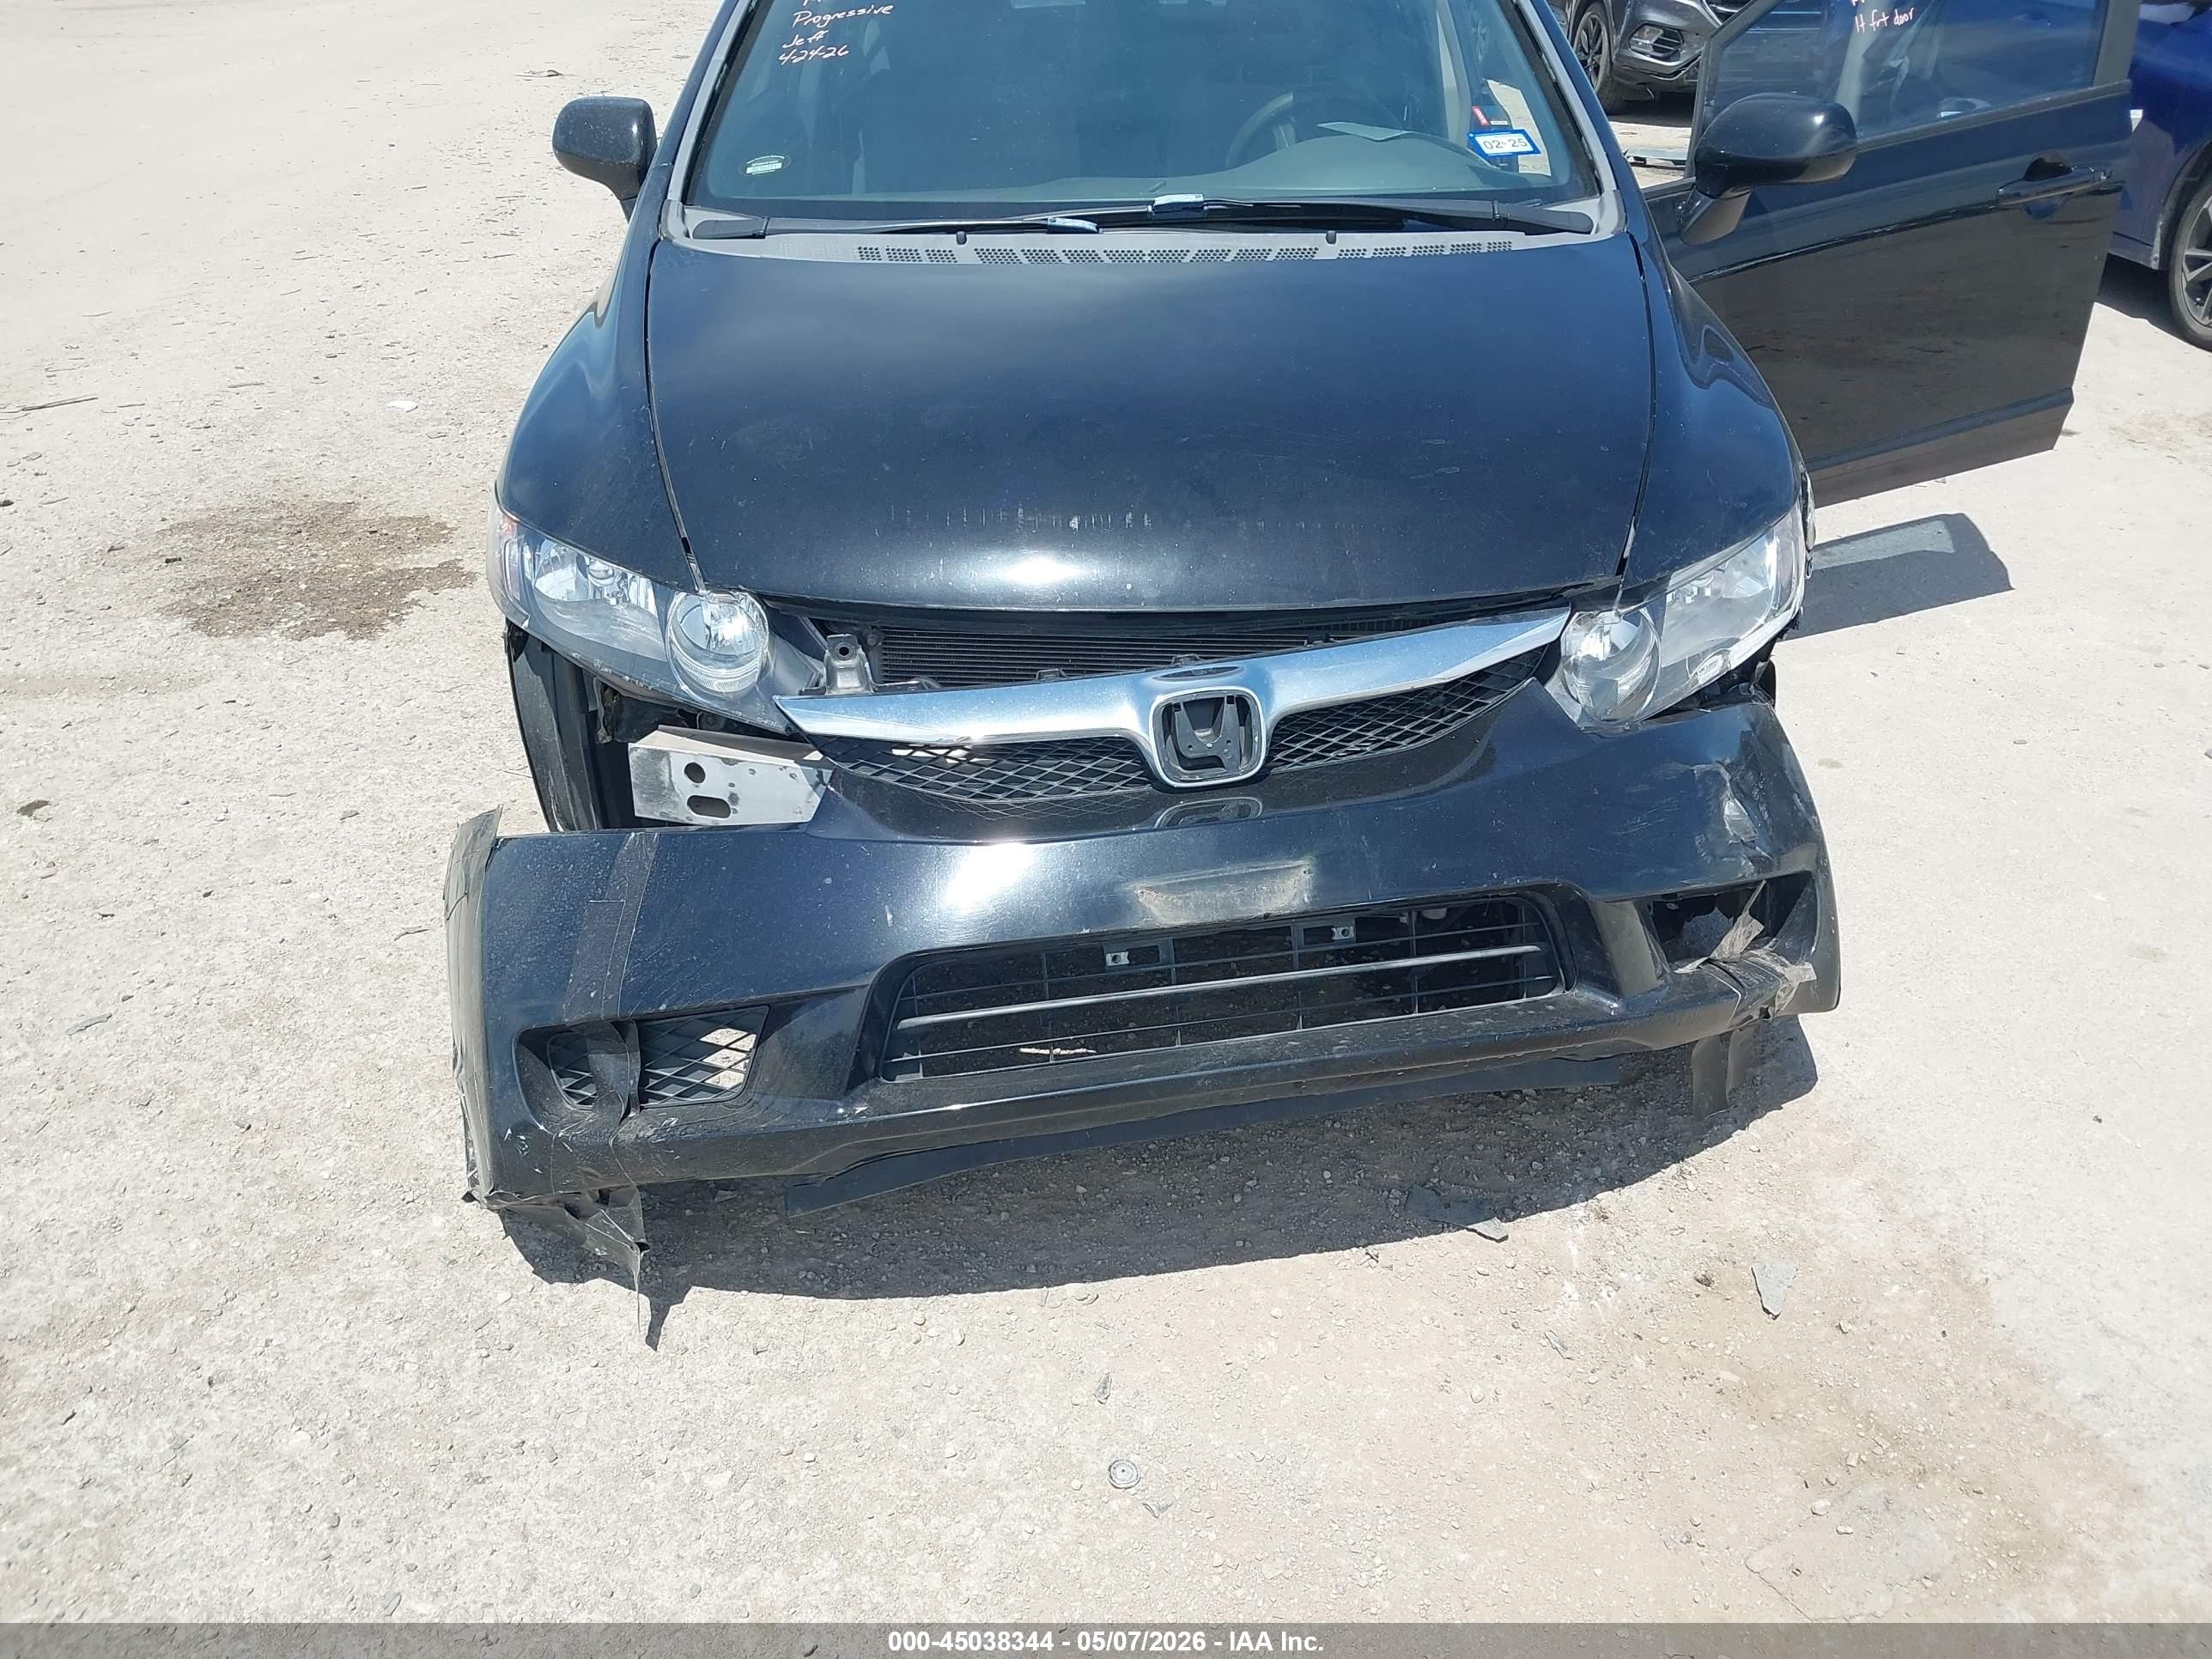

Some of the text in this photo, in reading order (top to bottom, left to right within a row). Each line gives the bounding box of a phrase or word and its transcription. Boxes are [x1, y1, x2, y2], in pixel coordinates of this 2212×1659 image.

[792, 4, 894, 28] Progressive
[1869, 9, 1890, 32] frt
[1893, 7, 1914, 26] door
[781, 29, 829, 49] Jeff
[778, 45, 850, 65] 4-24-26
